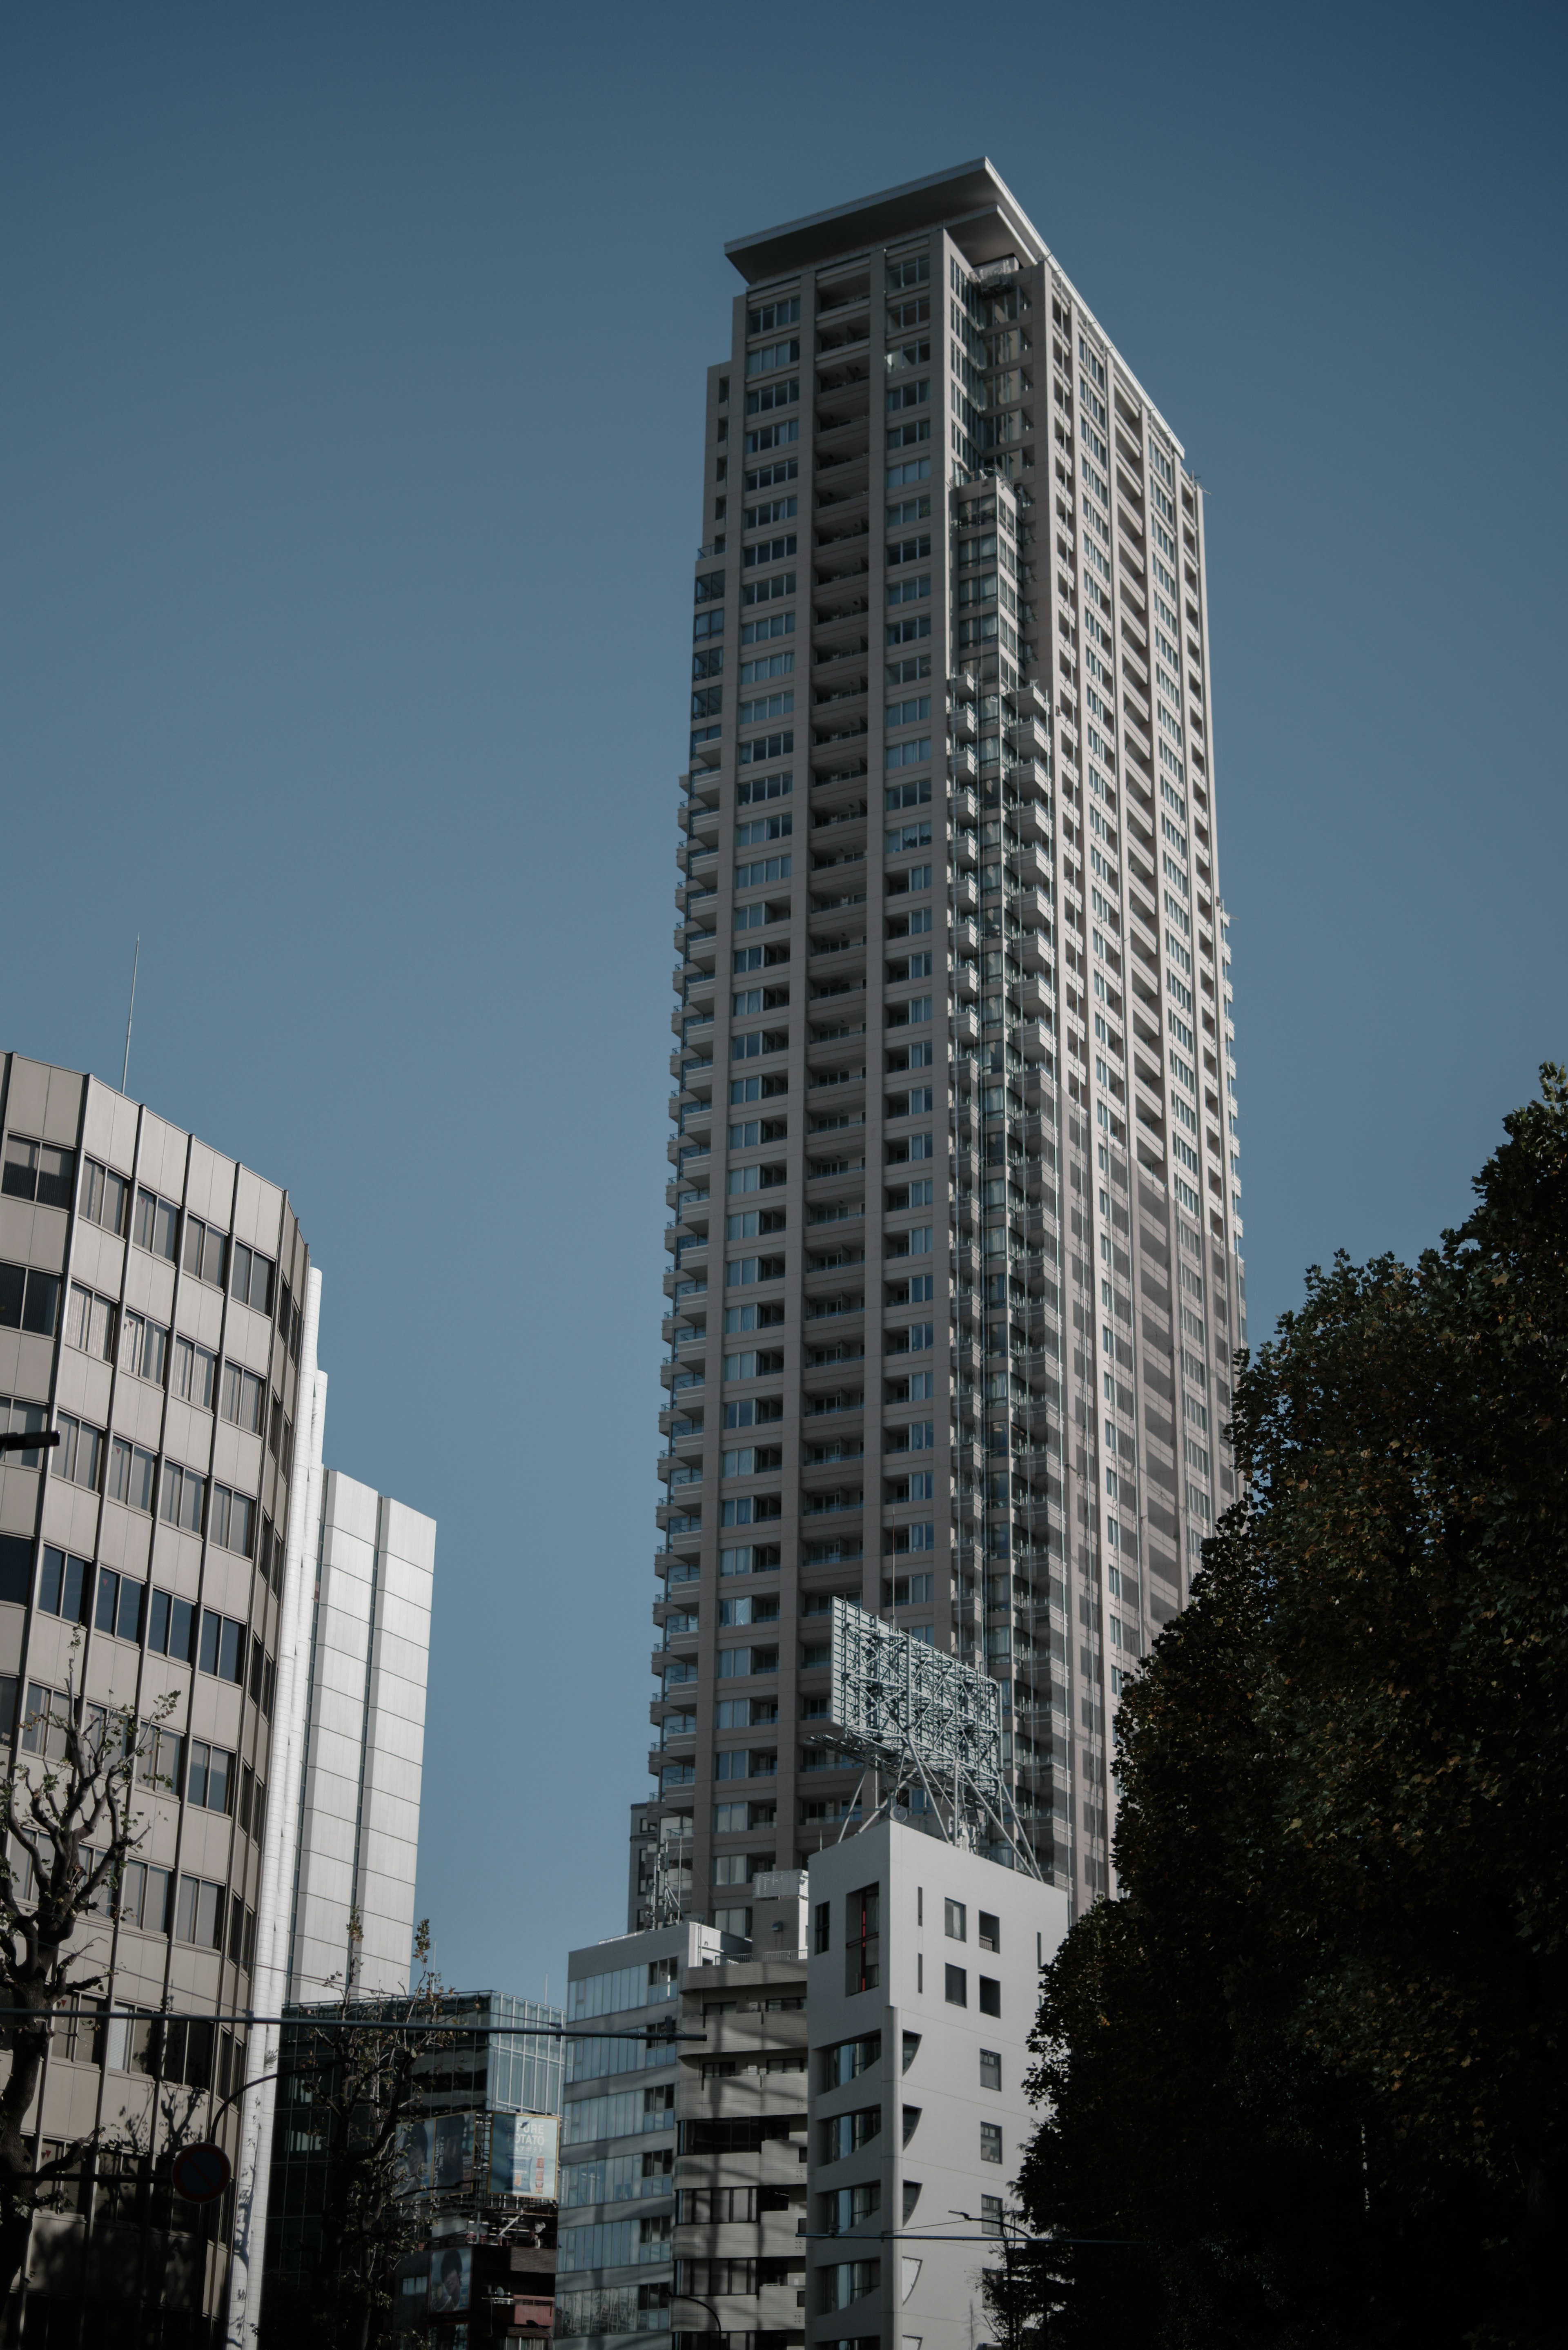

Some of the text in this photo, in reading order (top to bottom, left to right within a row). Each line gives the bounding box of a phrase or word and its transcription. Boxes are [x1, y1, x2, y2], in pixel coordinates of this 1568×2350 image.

[517, 2122, 544, 2134] PURE
[507, 2133, 544, 2146] POTATO
[508, 2145, 543, 2153] ピュアポテト
